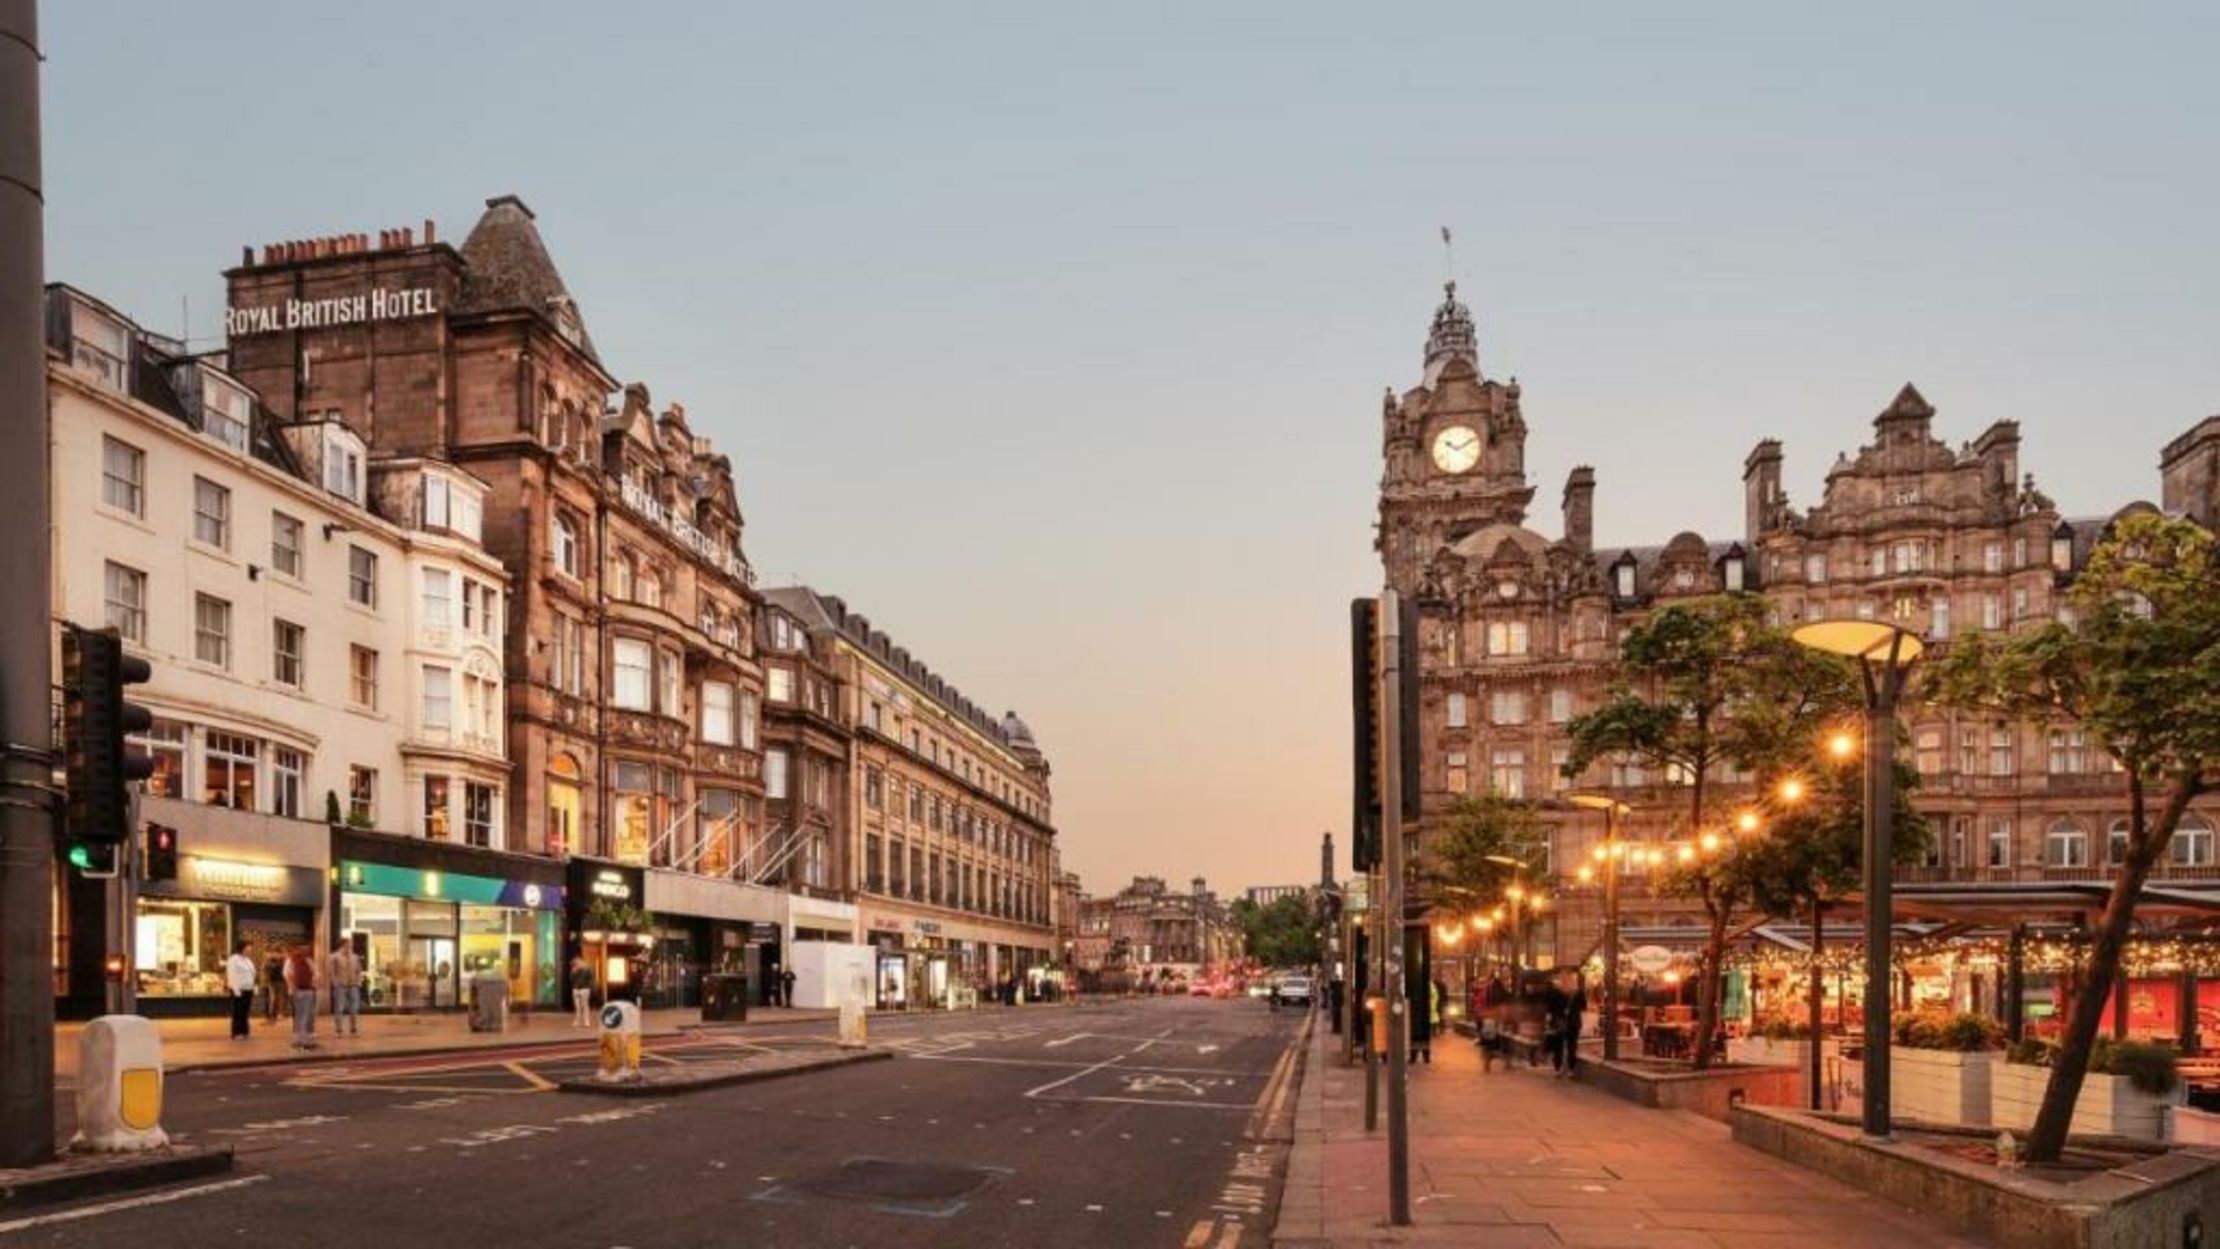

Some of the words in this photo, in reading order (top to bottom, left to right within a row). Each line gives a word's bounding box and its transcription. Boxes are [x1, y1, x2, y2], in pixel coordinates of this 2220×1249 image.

[224, 306, 283, 336] ROYAL
[286, 296, 365, 329] BRITISH
[372, 287, 437, 320] HOTEL
